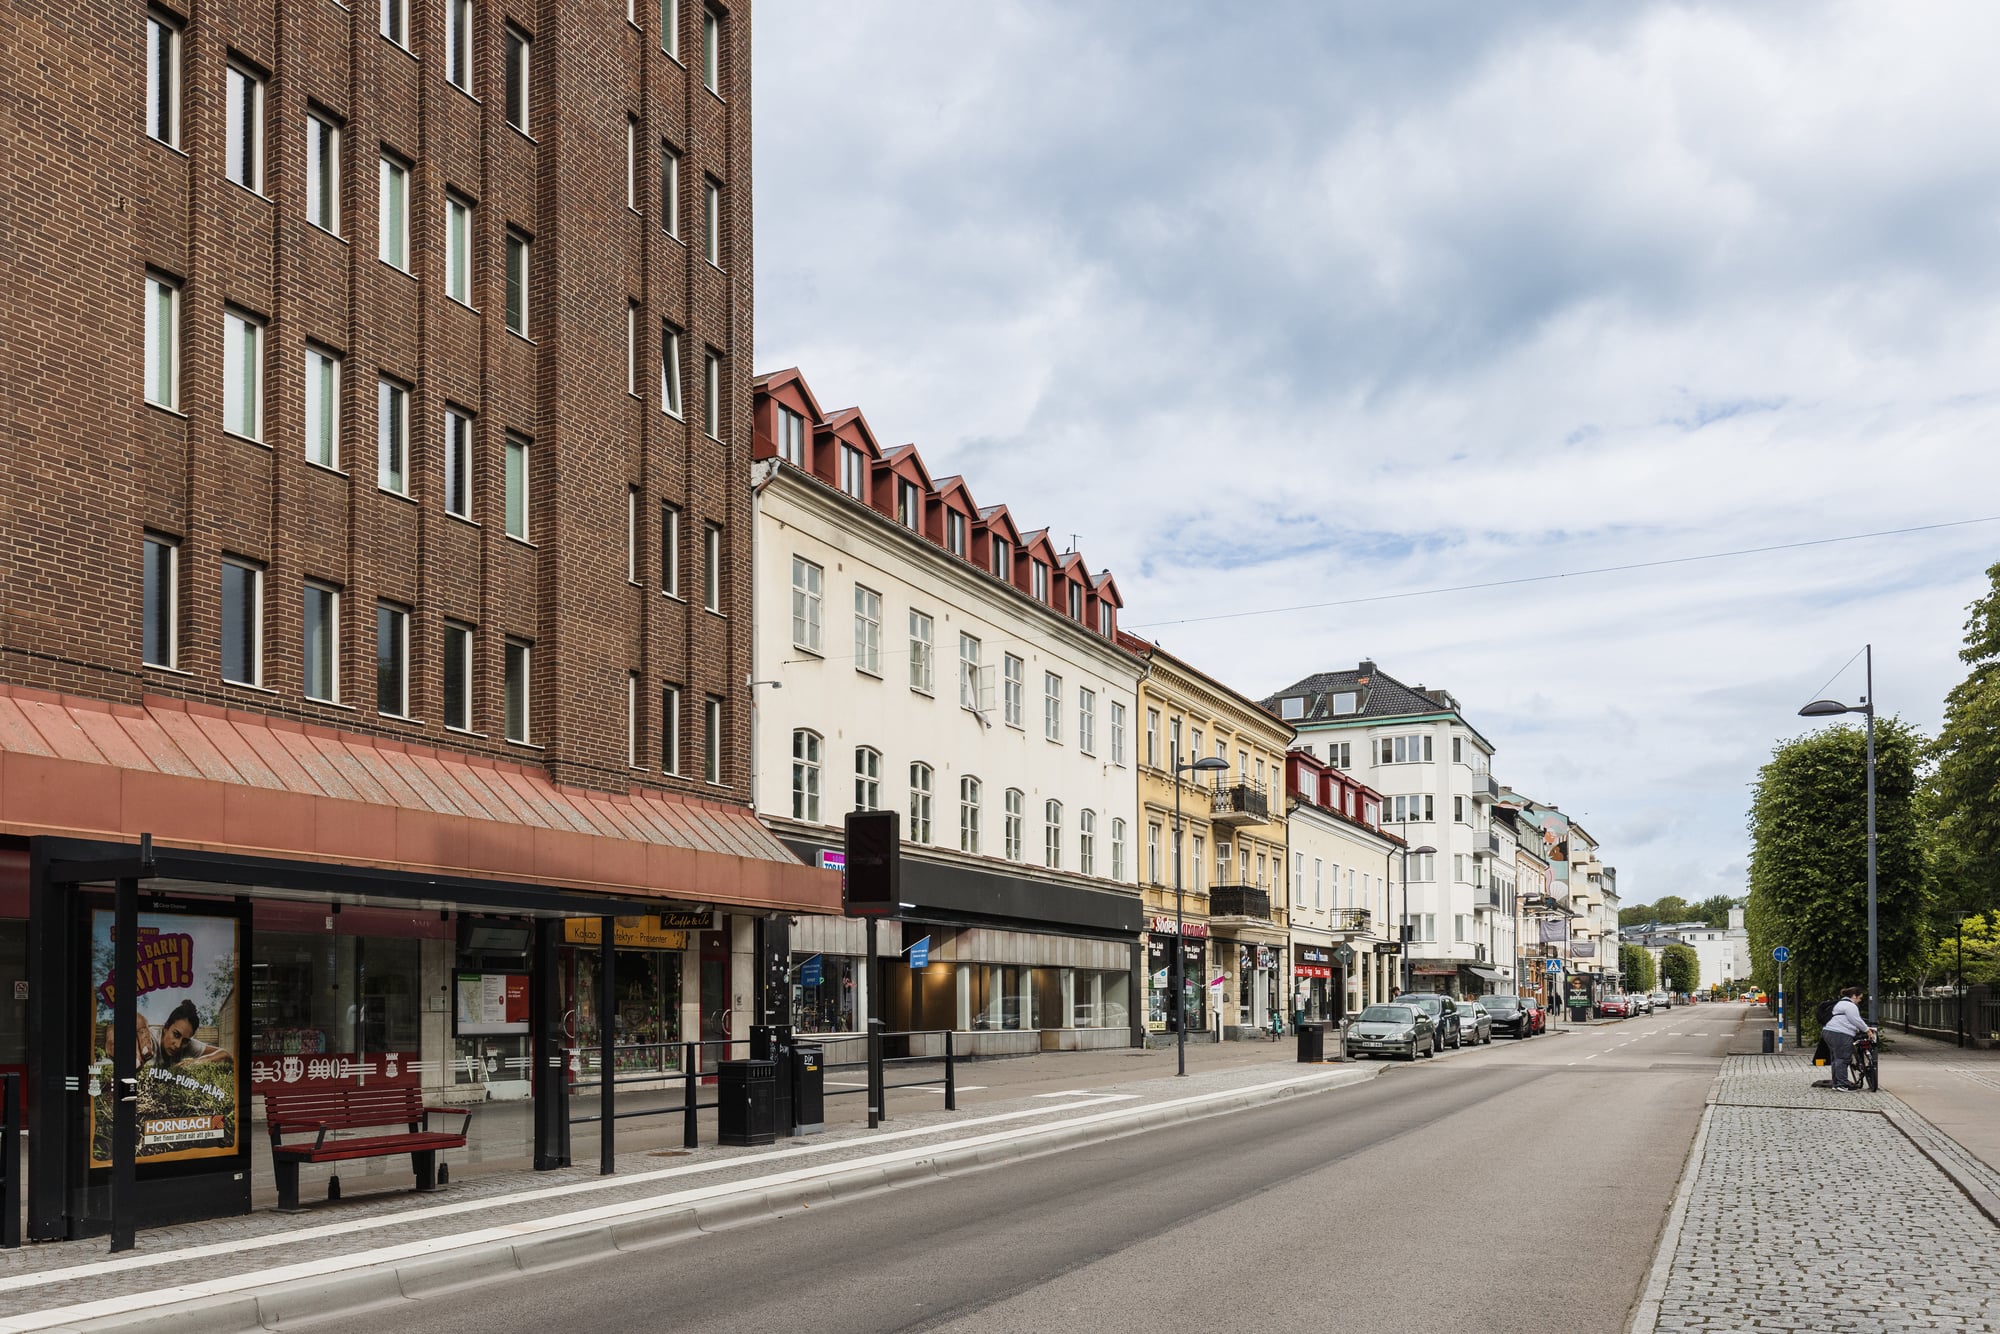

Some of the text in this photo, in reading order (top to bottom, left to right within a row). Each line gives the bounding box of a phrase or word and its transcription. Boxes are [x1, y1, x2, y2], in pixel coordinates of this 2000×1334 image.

[574, 928, 668, 944] Kakao fektyr Presenter
[144, 938, 178, 959] BARN
[148, 1067, 225, 1101] PLIPP-PLOPP-PLAPP
[146, 1117, 211, 1133] HORNBACH
